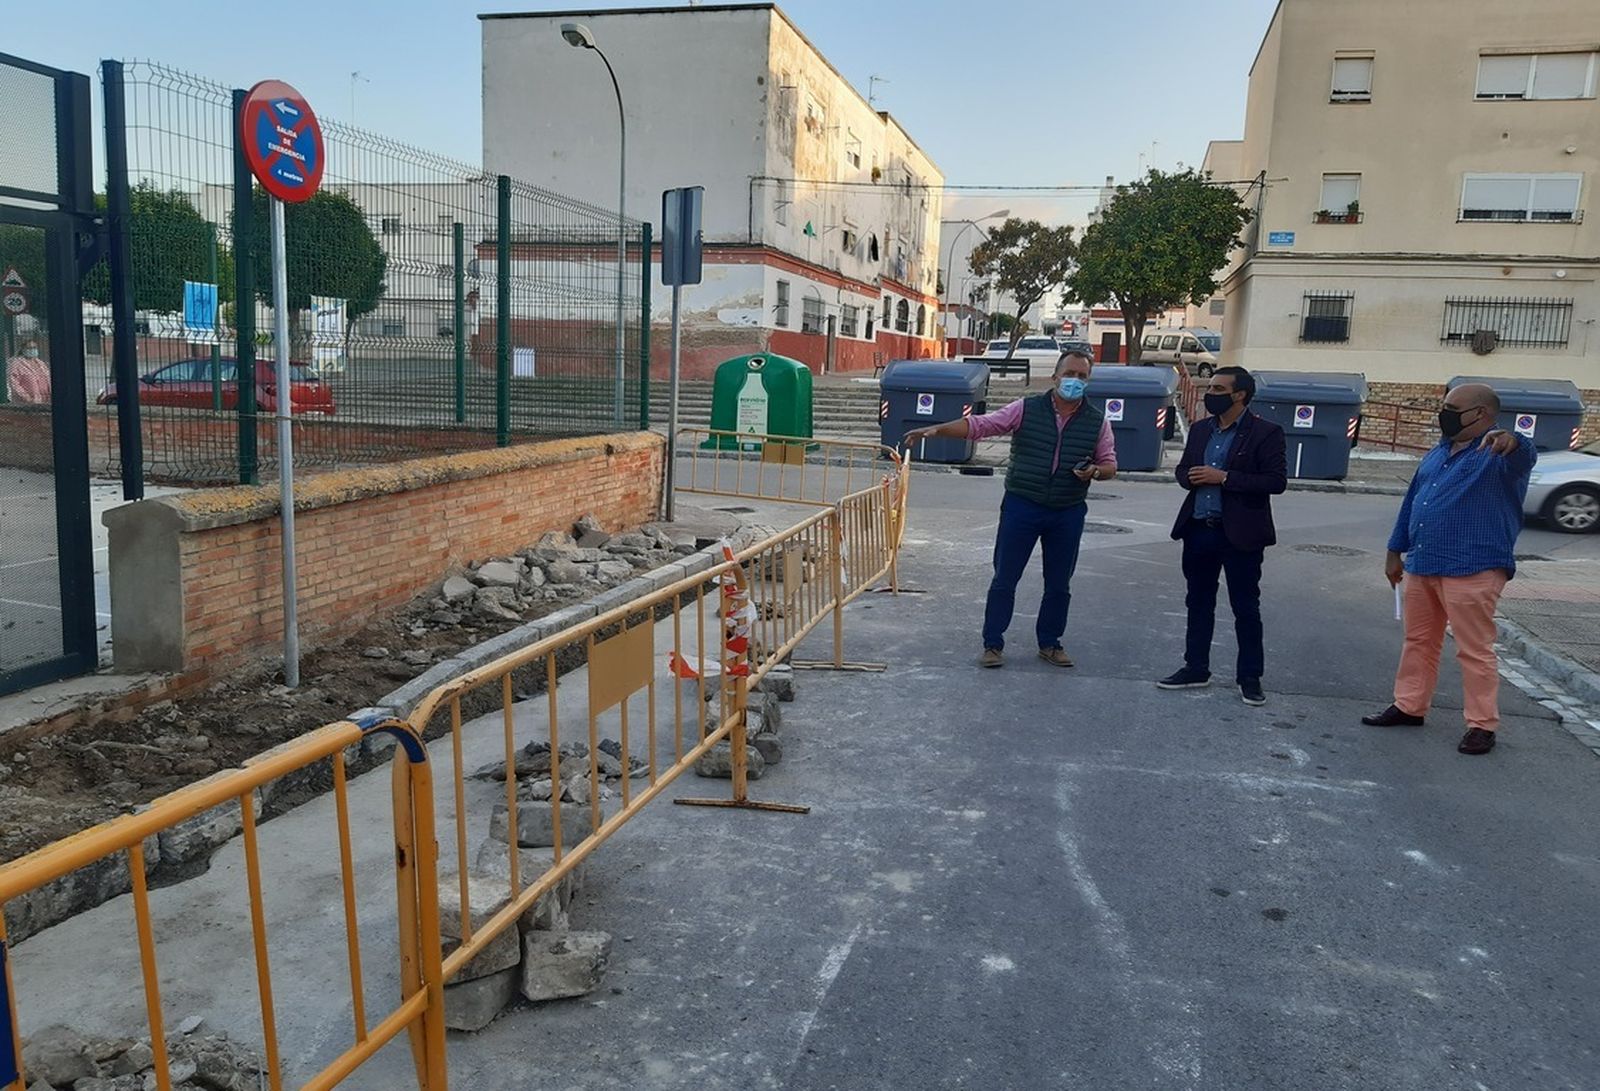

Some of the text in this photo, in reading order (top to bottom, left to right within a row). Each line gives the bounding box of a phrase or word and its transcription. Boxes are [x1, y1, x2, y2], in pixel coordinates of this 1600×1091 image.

[276, 125, 297, 138] SALIDA
[282, 138, 291, 146] DE
[267, 142, 305, 161] EMERGENCIA
